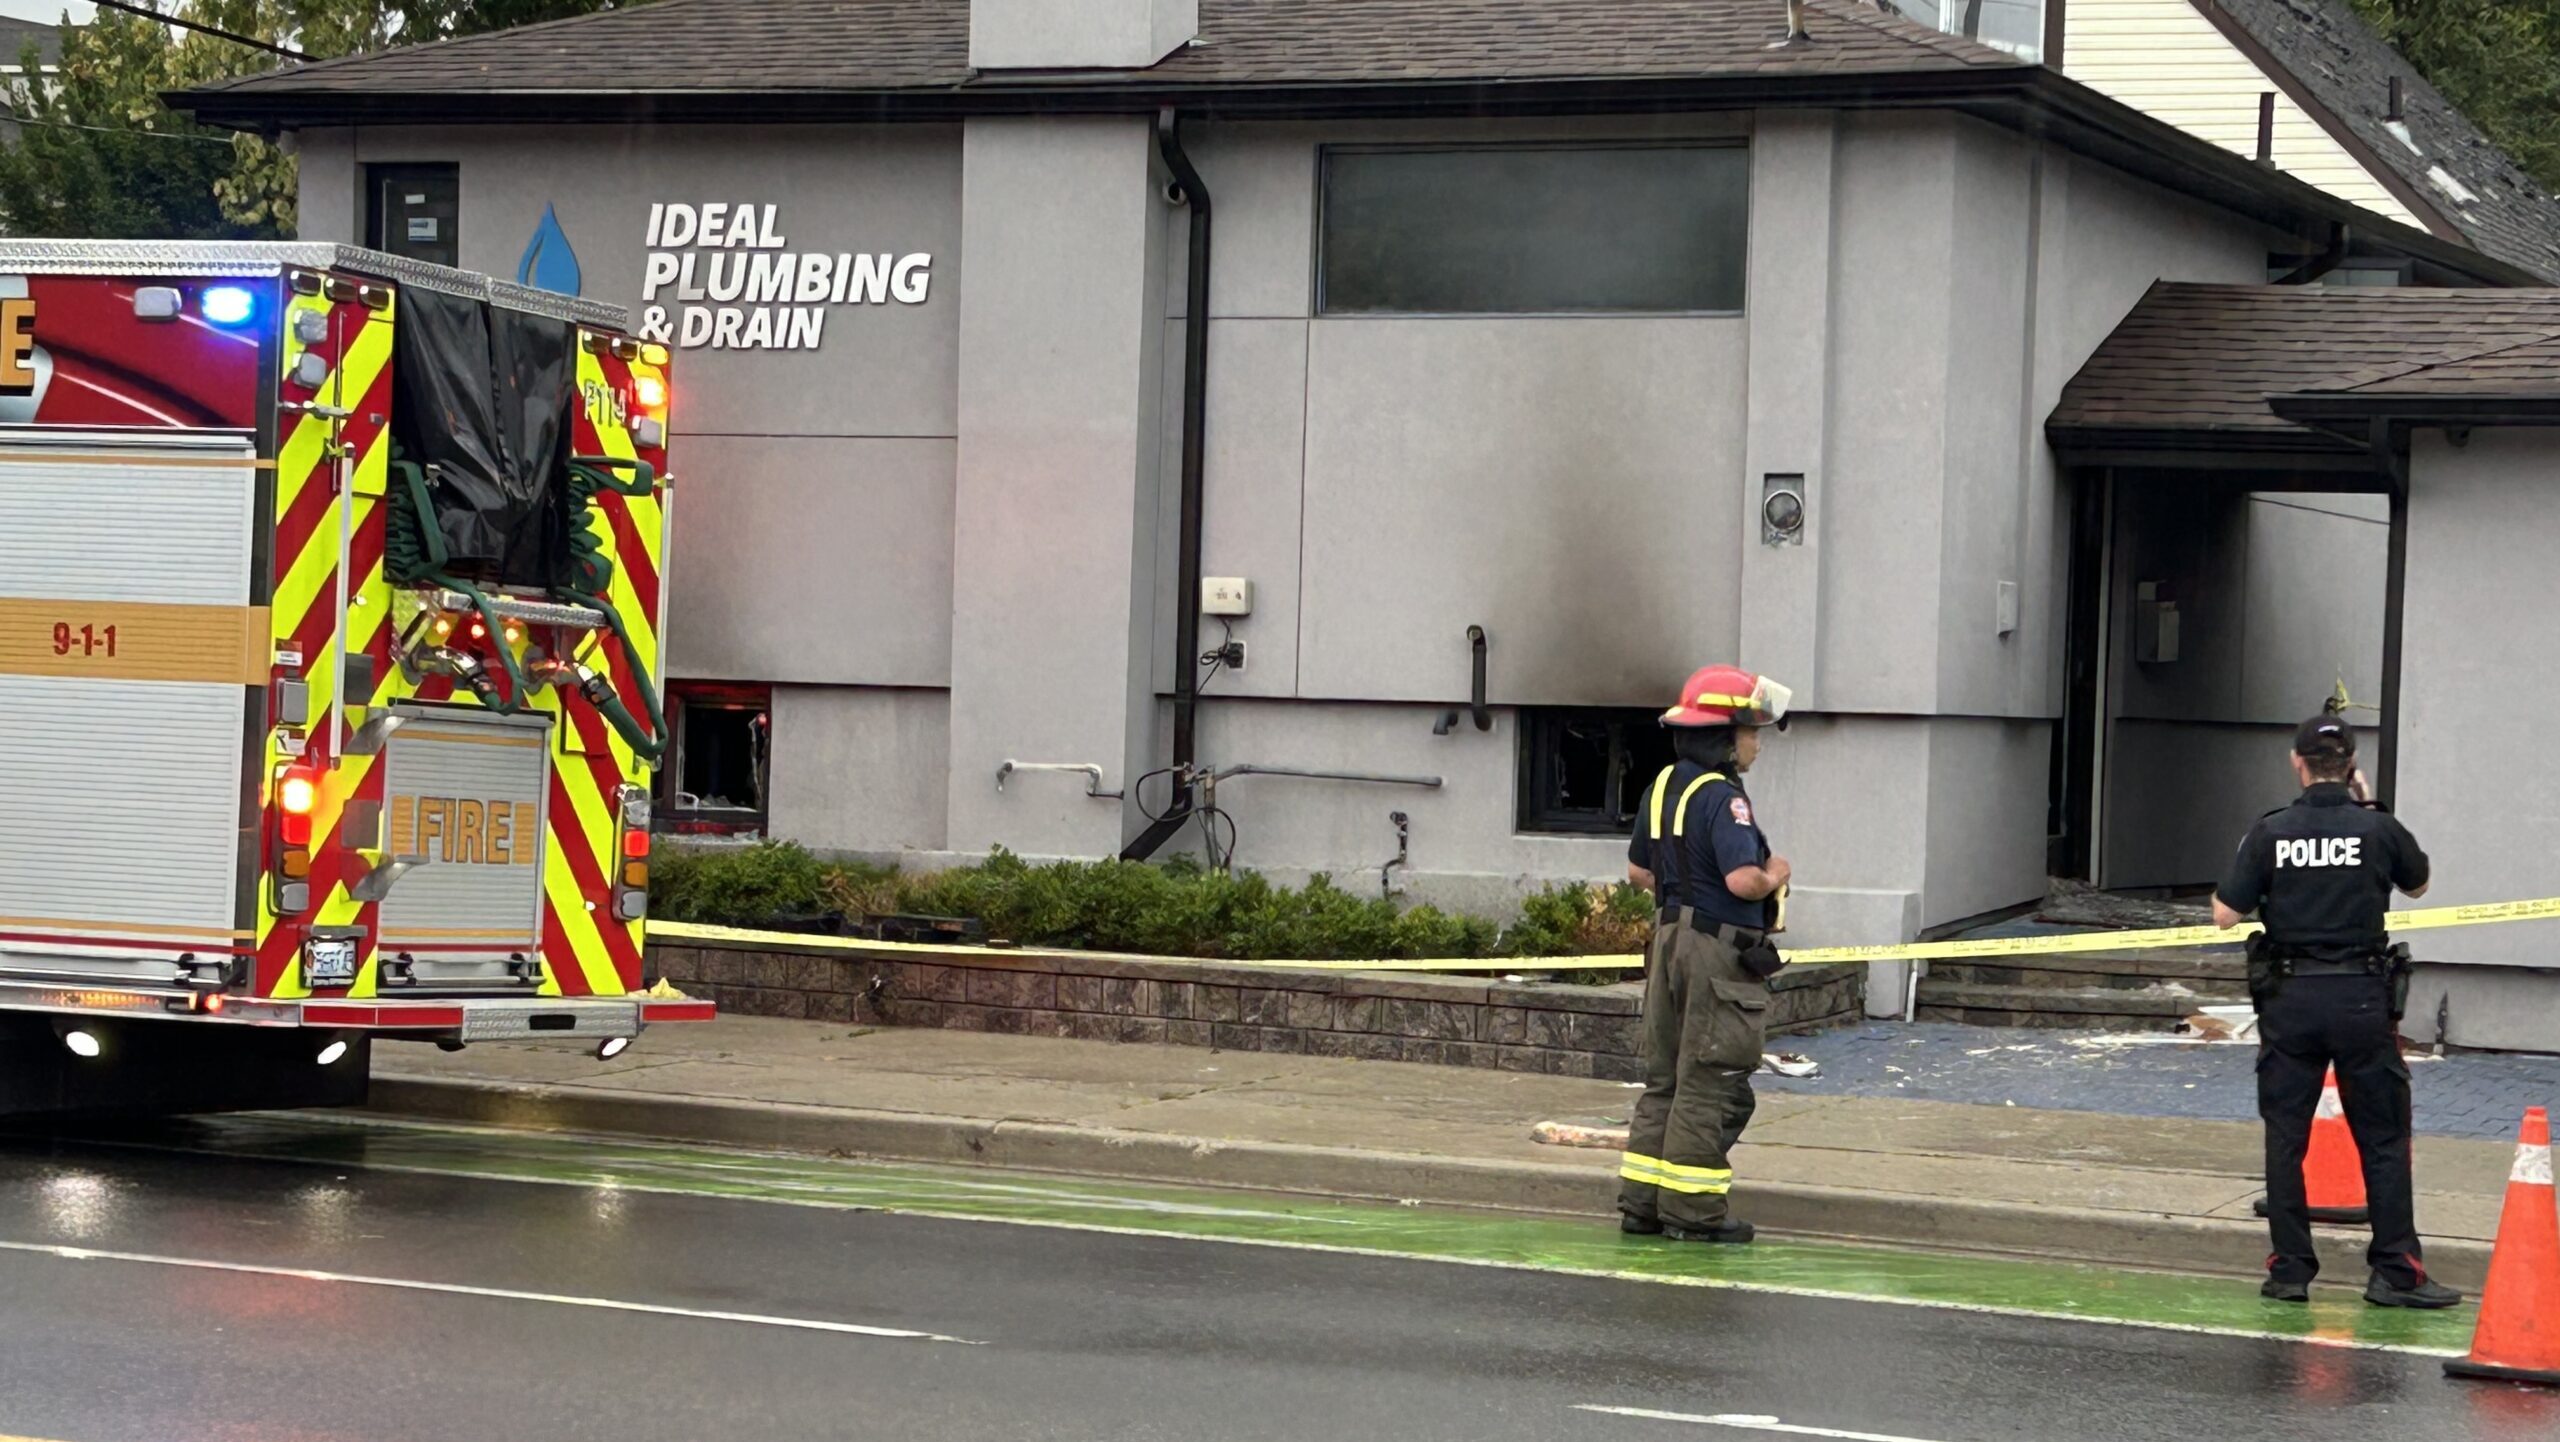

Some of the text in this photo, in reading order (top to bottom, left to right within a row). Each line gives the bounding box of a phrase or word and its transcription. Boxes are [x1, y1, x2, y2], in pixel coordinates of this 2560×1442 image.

[646, 203, 786, 249] IDEAL
[642, 252, 932, 304] PLUMBING
[638, 305, 825, 349] & DRAIN
[53, 622, 117, 657] 9-1-1
[417, 796, 512, 865] FIRE
[2275, 837, 2362, 868] POLICE
